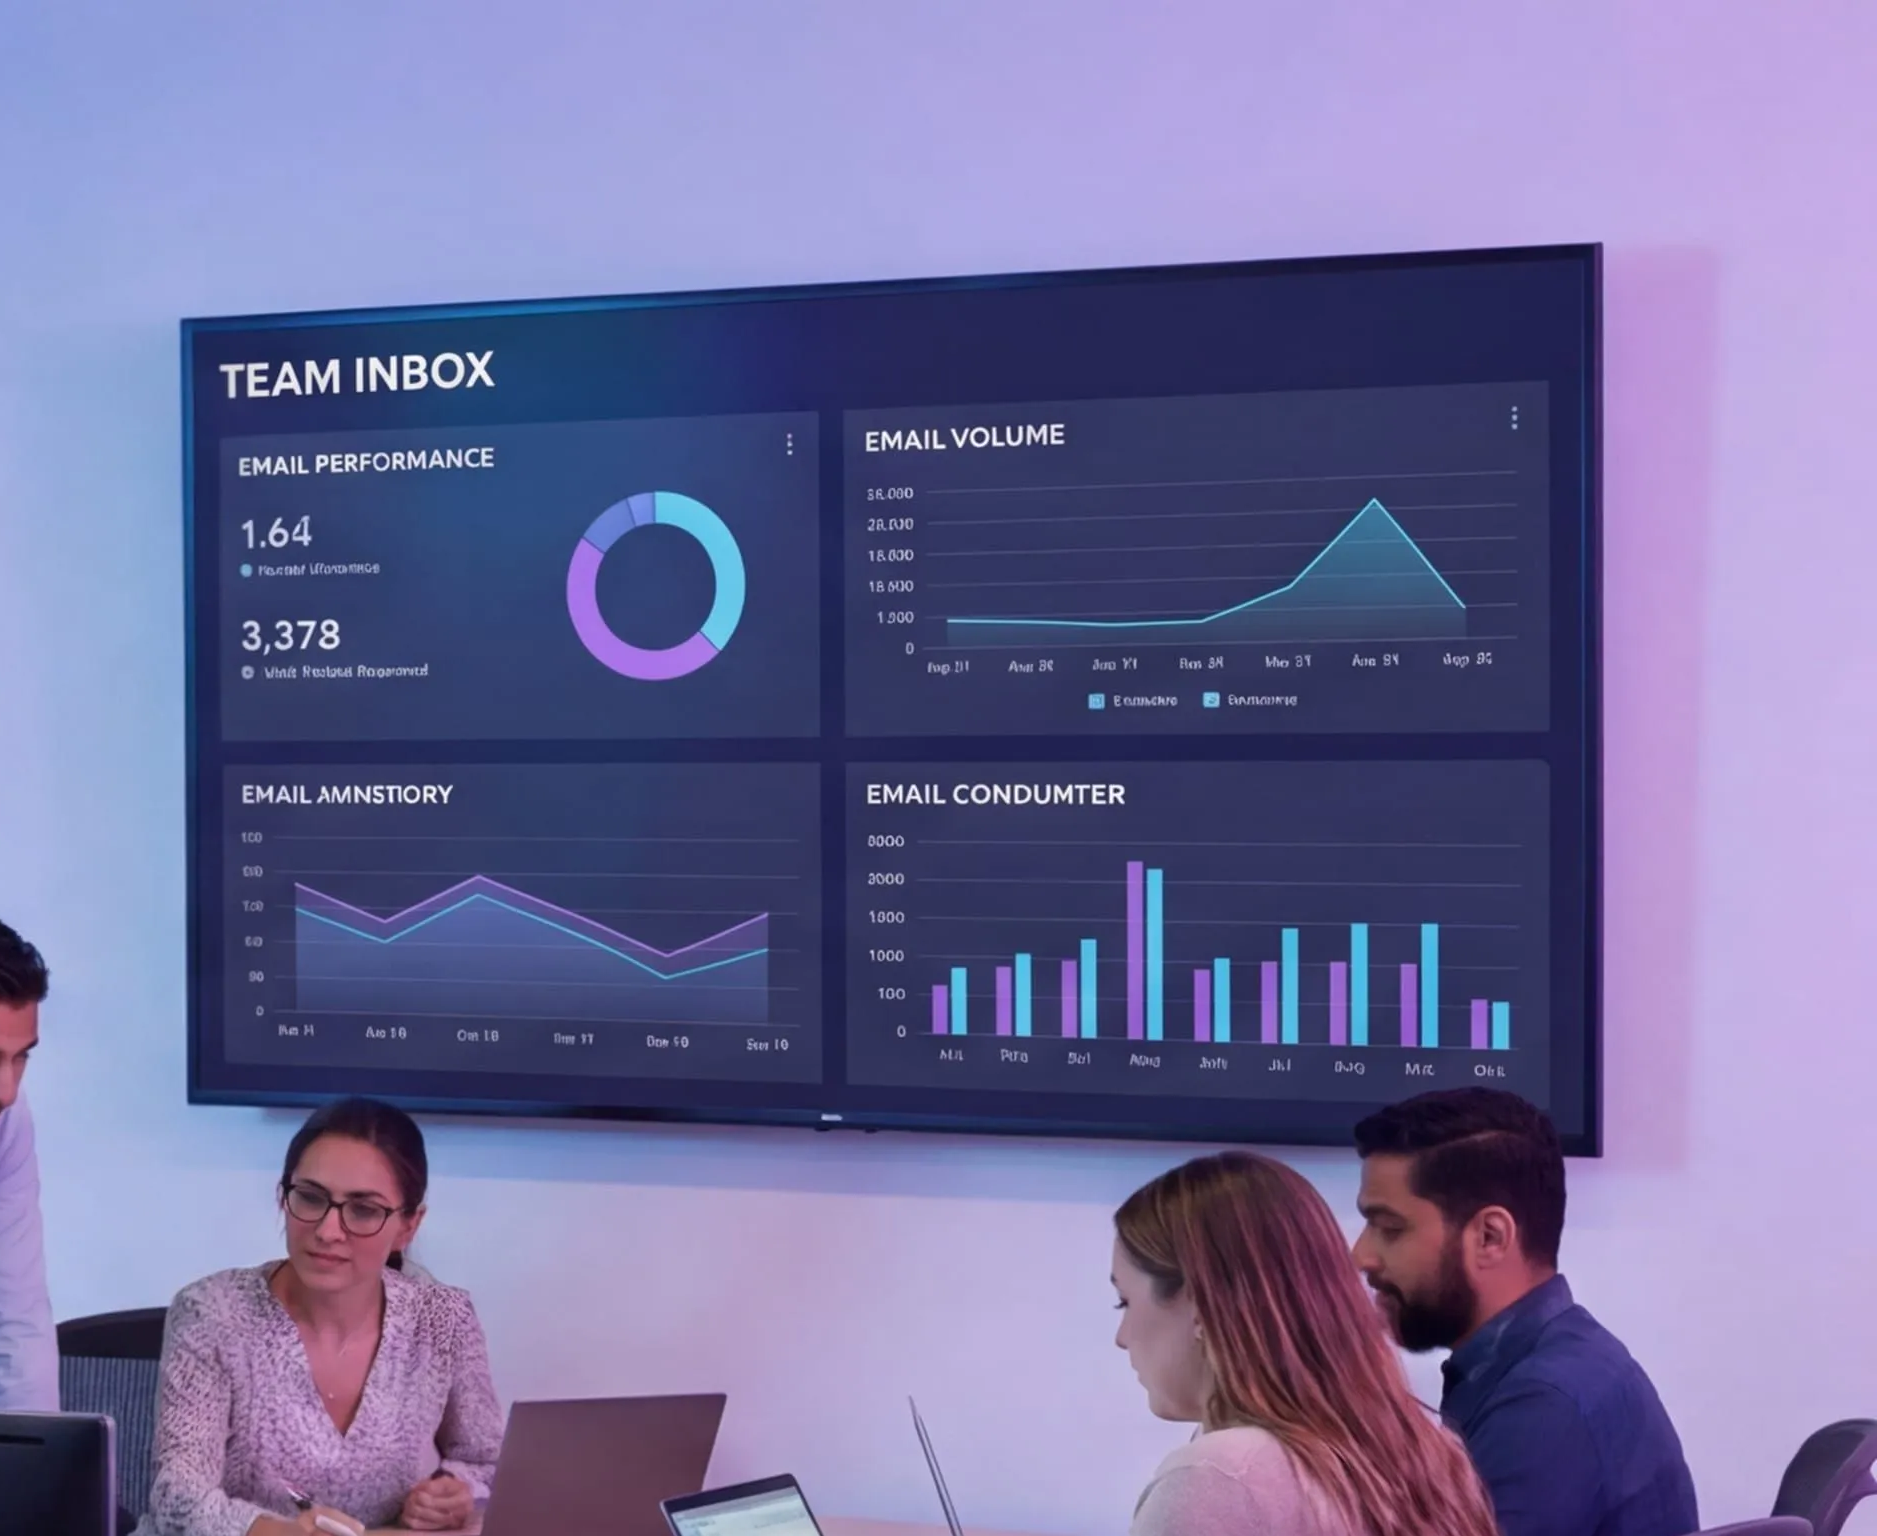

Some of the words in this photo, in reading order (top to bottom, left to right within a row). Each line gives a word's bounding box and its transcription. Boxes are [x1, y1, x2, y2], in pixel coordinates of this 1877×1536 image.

[219, 358, 341, 399] TEAM
[355, 350, 496, 393] INBOX
[865, 429, 947, 452] EMAIL
[950, 423, 1065, 449] VOLUME
[238, 455, 310, 477] EMAIL
[315, 447, 495, 474] PERFORMANCE
[241, 515, 313, 549] 1.64
[242, 618, 341, 656] 3,378
[242, 784, 313, 804] EMAIL
[867, 783, 947, 805] EMAIL
[952, 783, 1126, 805] CONDUMTER
[868, 949, 905, 962] 1000
[896, 1024, 907, 1038] 0
